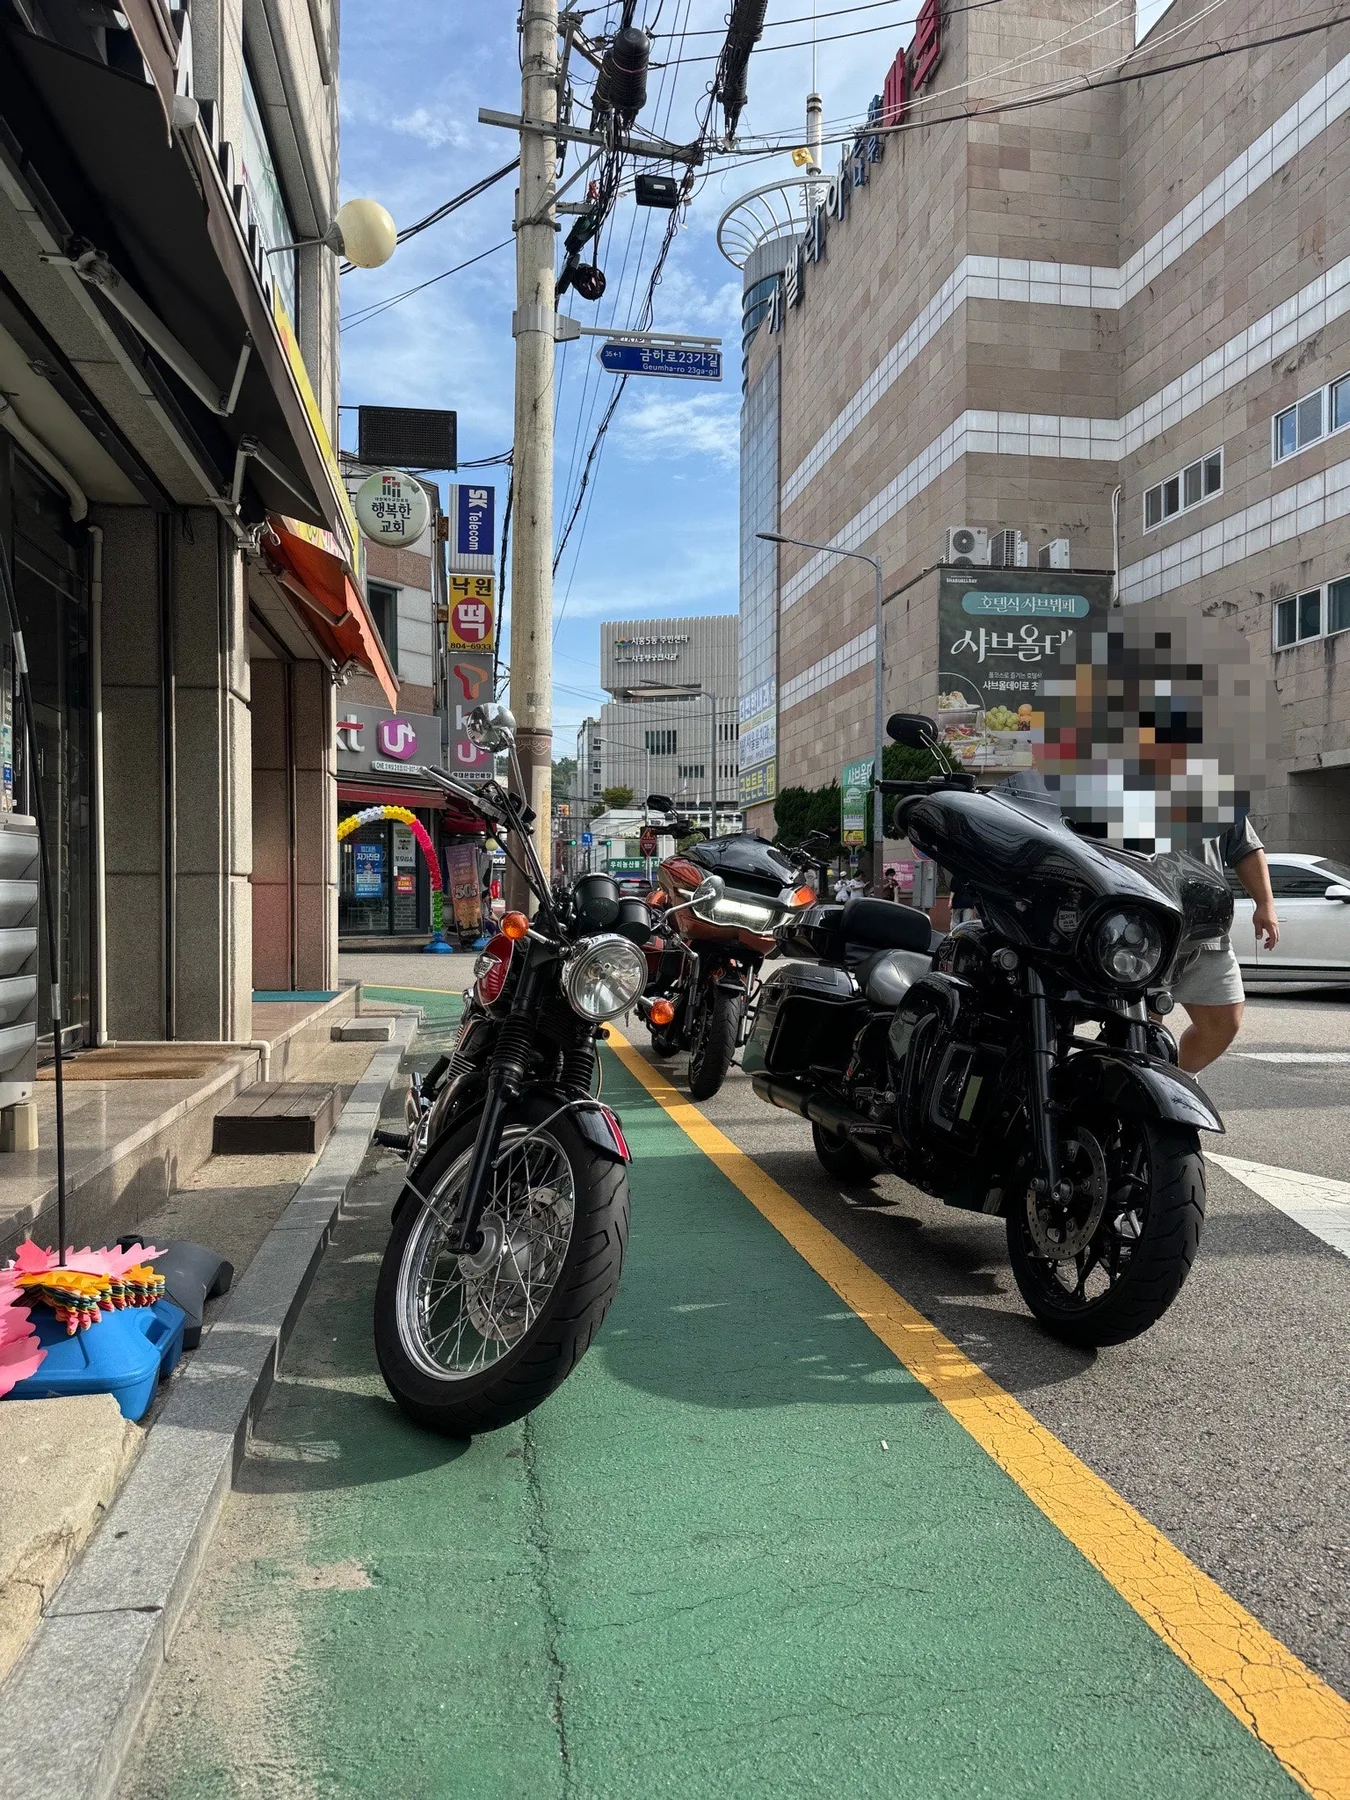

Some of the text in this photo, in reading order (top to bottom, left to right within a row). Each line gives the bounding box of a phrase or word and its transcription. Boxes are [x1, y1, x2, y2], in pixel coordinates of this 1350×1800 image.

[640, 348, 718, 368] 금하로23가길
[642, 362, 718, 376] Geumha-ro 23ga-gil
[371, 502, 412, 520] 행복한
[468, 489, 488, 551] SK Telecom
[380, 520, 405, 536] 교회
[451, 577, 492, 597] 낙원
[977, 595, 1075, 614] 호텔식 샤브뷔페
[457, 604, 486, 640] 떡
[450, 642, 492, 651] 804-6933
[983, 680, 1029, 692] 샤브올데이로
[610, 860, 640, 869] 우리농산물
